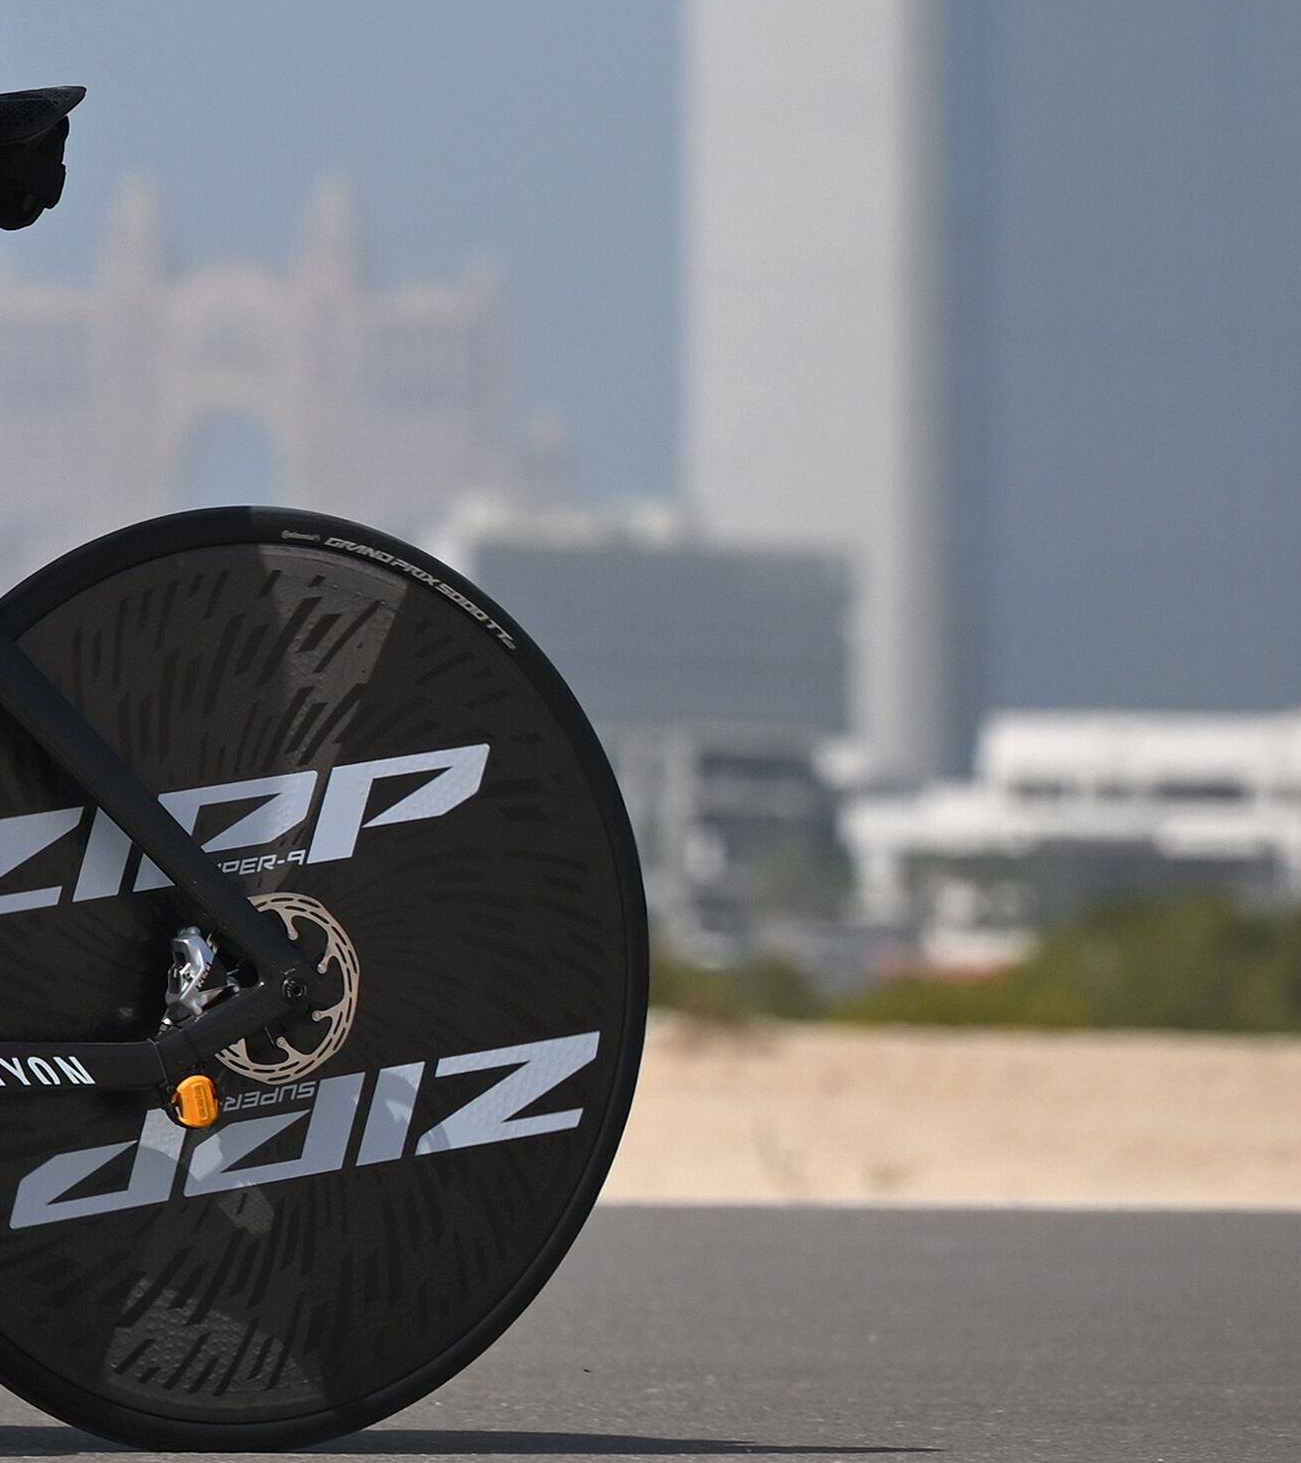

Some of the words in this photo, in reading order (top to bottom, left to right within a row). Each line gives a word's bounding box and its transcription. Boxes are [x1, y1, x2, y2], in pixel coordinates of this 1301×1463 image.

[324, 537, 394, 564] GRAND
[390, 558, 441, 586] PRIX
[435, 583, 490, 622] 5000
[218, 850, 307, 876] PER-9
[223, 1081, 317, 1113] SUPER
[9, 1031, 600, 1229] ZIPP
